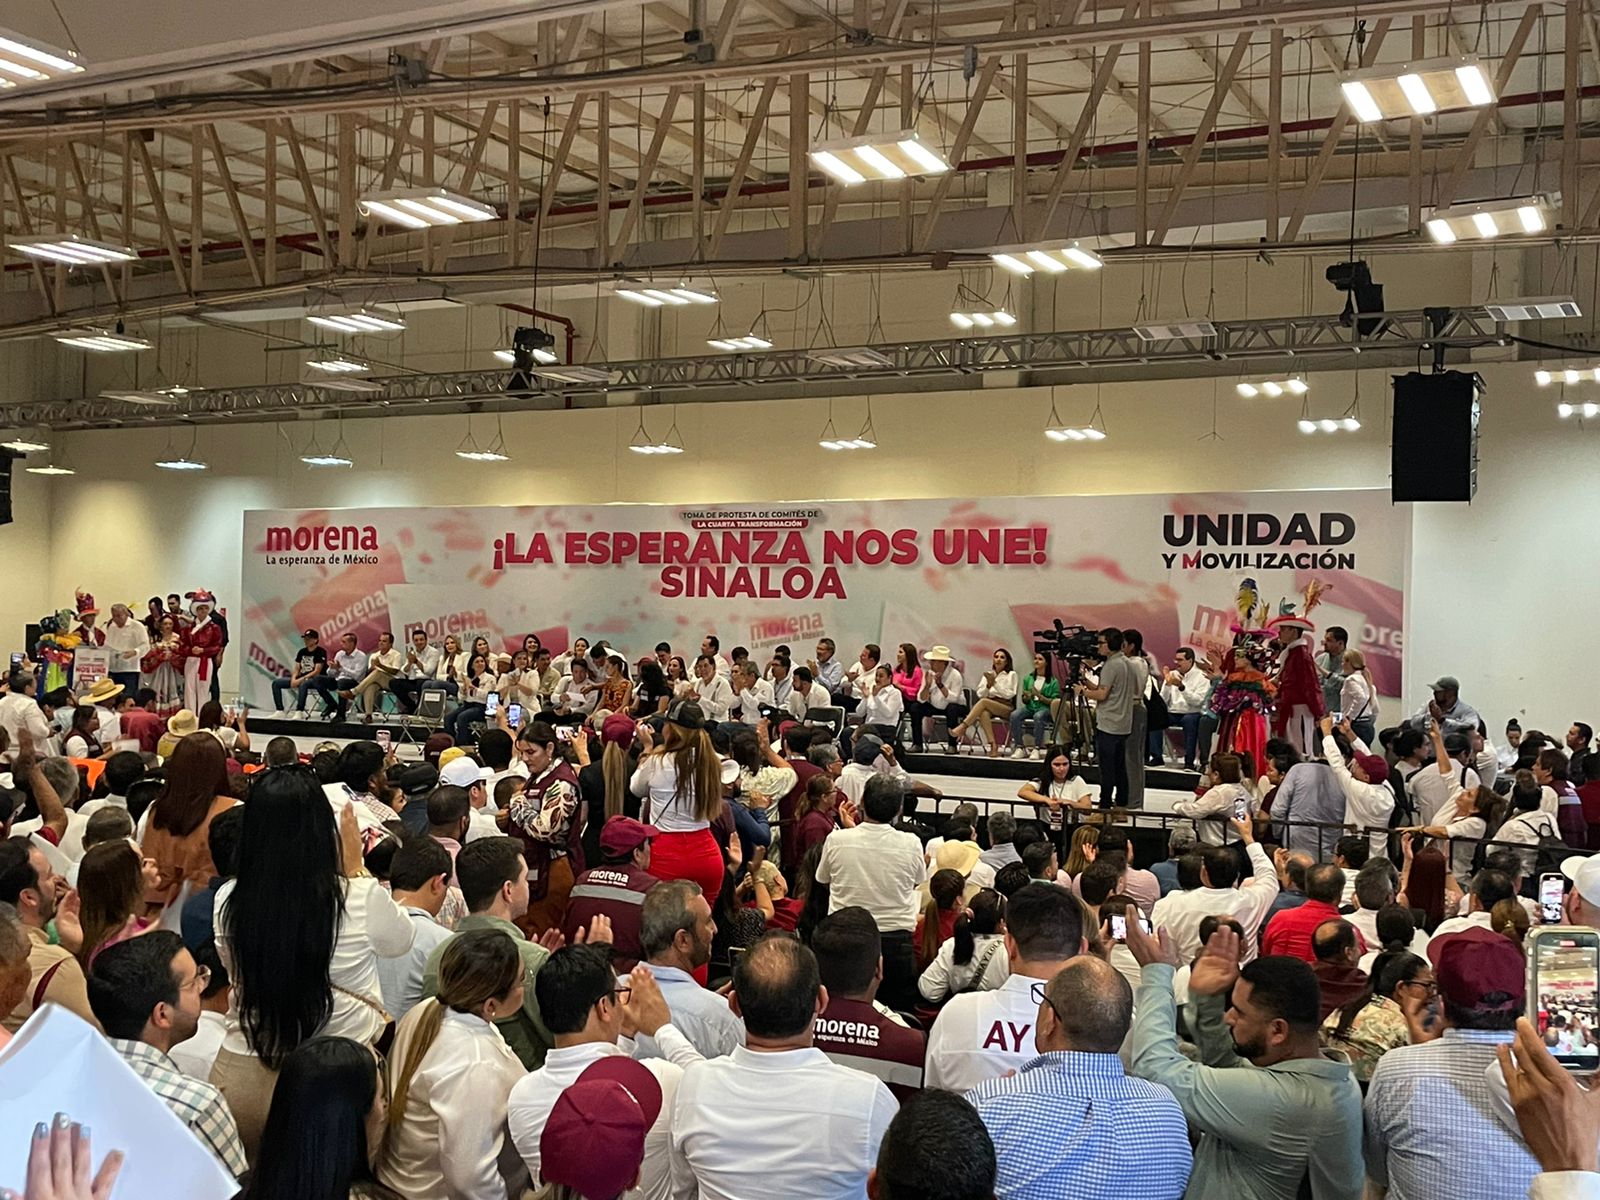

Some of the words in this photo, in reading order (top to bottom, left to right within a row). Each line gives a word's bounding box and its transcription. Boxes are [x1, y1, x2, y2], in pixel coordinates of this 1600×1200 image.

[683, 511, 704, 519] TOMA
[706, 511, 717, 519] DE
[718, 511, 757, 519] PROTESTA
[771, 510, 804, 518] COMITÉS
[808, 510, 818, 518] DE
[737, 520, 802, 528] TRANSFORMACIÓN
[266, 525, 379, 551] morena
[1163, 512, 1356, 547] UNIDAD
[266, 555, 277, 565] La
[279, 555, 326, 567] esperanza
[328, 554, 340, 565] de
[343, 554, 379, 565] México
[493, 532, 554, 570] ¡LA
[564, 530, 811, 565] ESPERANZA
[823, 529, 920, 566] NOS
[932, 527, 1049, 565] UNE!
[1161, 553, 1177, 569] Y
[1182, 548, 1355, 569] MOVILIZACIÓN
[660, 566, 847, 600] SINALOA
[320, 590, 388, 640] morena
[404, 608, 489, 645] morena
[750, 612, 824, 641] morena
[589, 869, 630, 883] morena
[812, 1018, 880, 1040] morena
[982, 1020, 1032, 1054] AY
